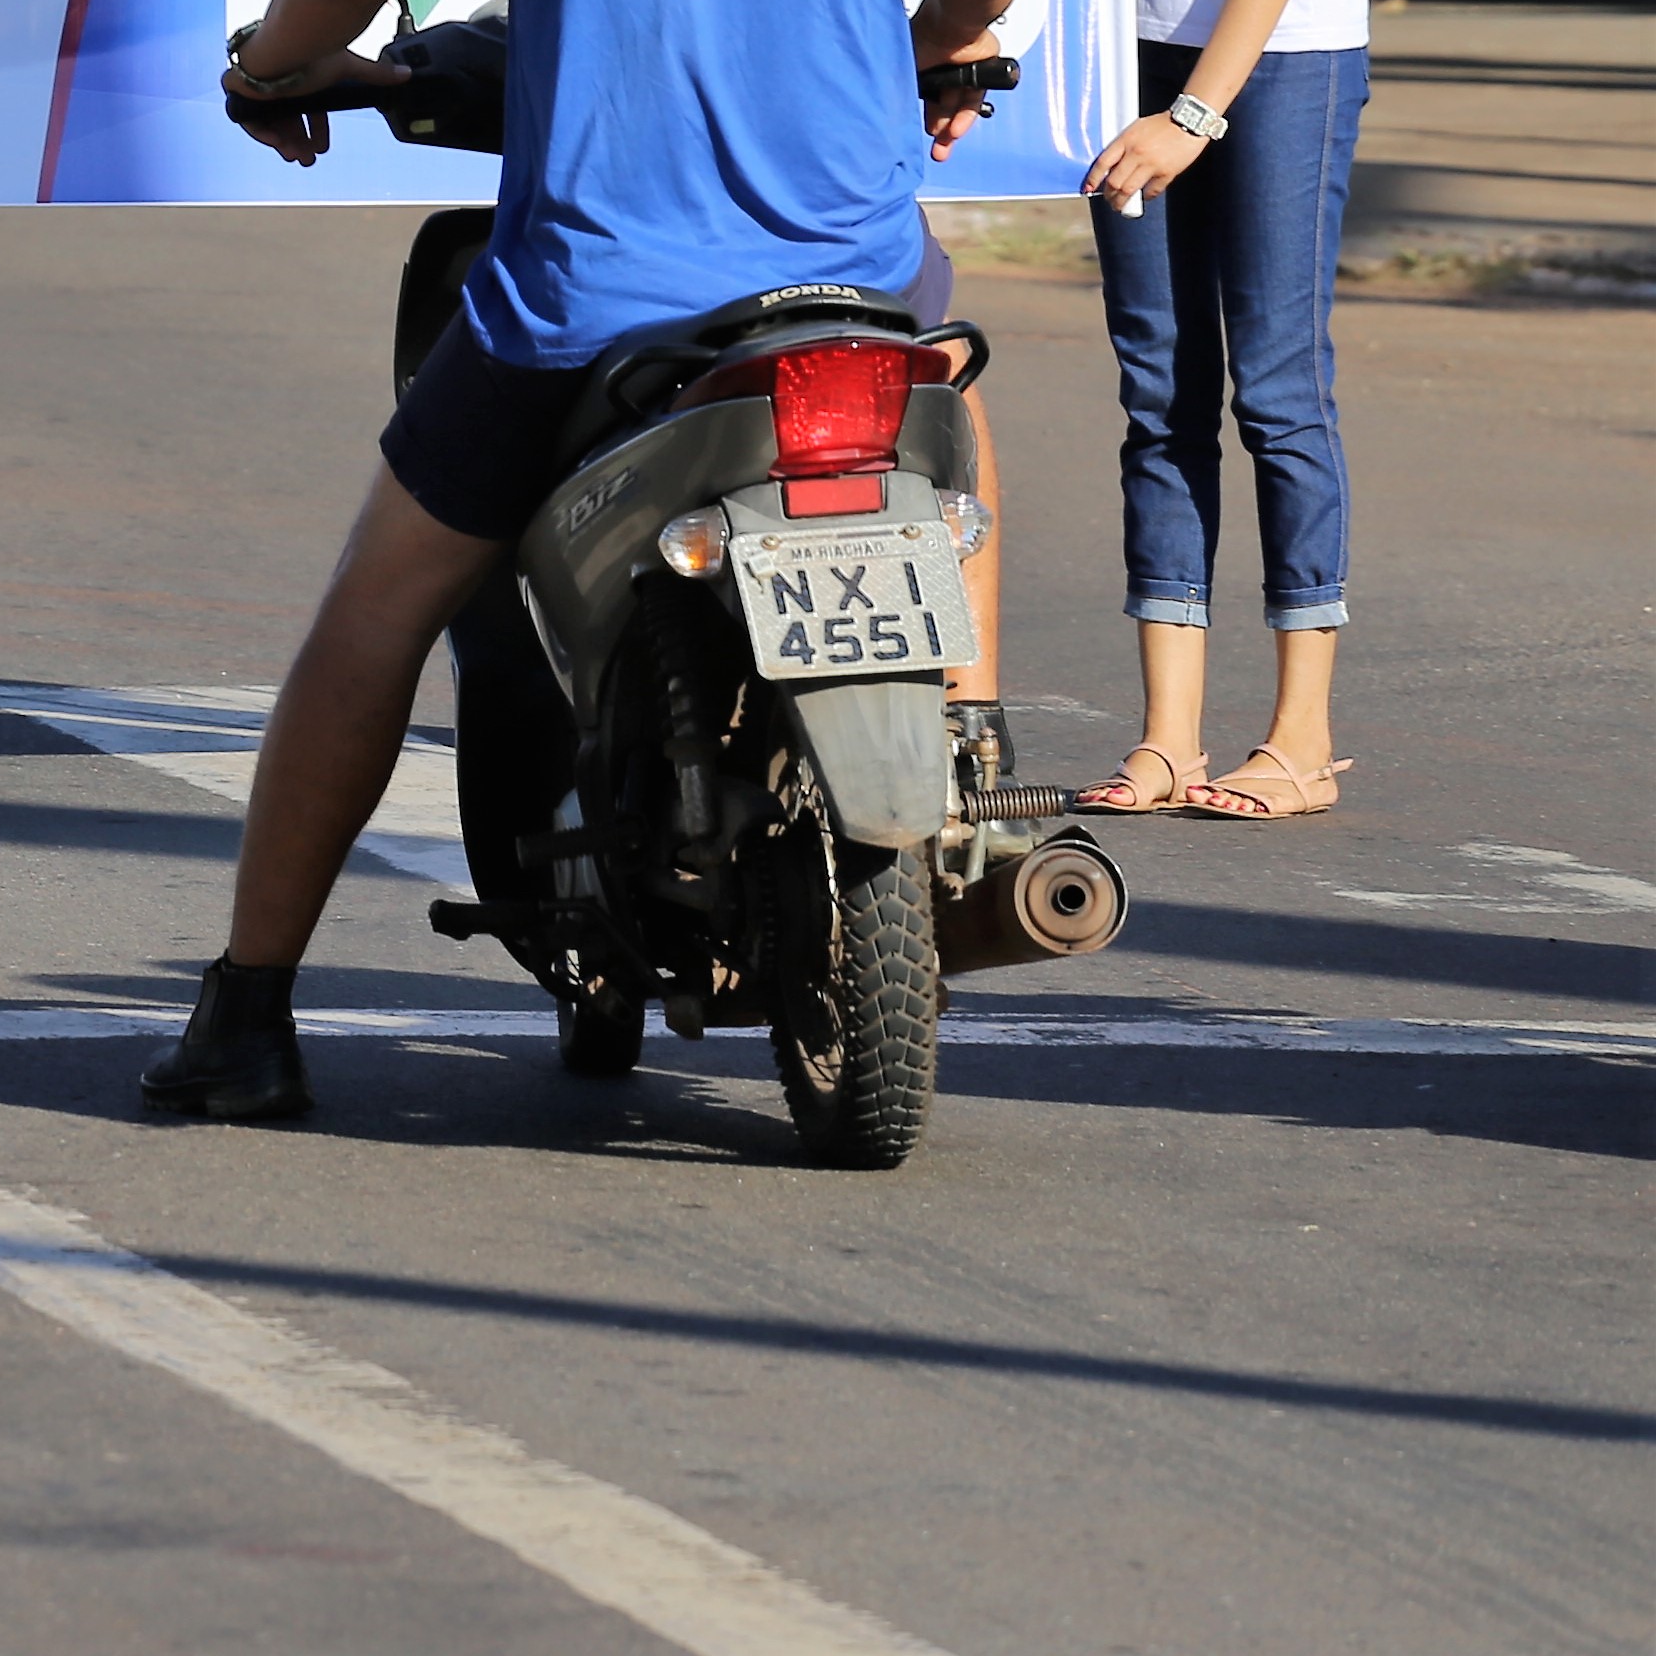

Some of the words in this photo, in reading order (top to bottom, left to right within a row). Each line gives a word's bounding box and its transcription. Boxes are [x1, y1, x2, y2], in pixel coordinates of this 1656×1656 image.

[759, 284, 863, 309] HONDA
[771, 561, 922, 615] NXI
[779, 612, 943, 666] 4551
